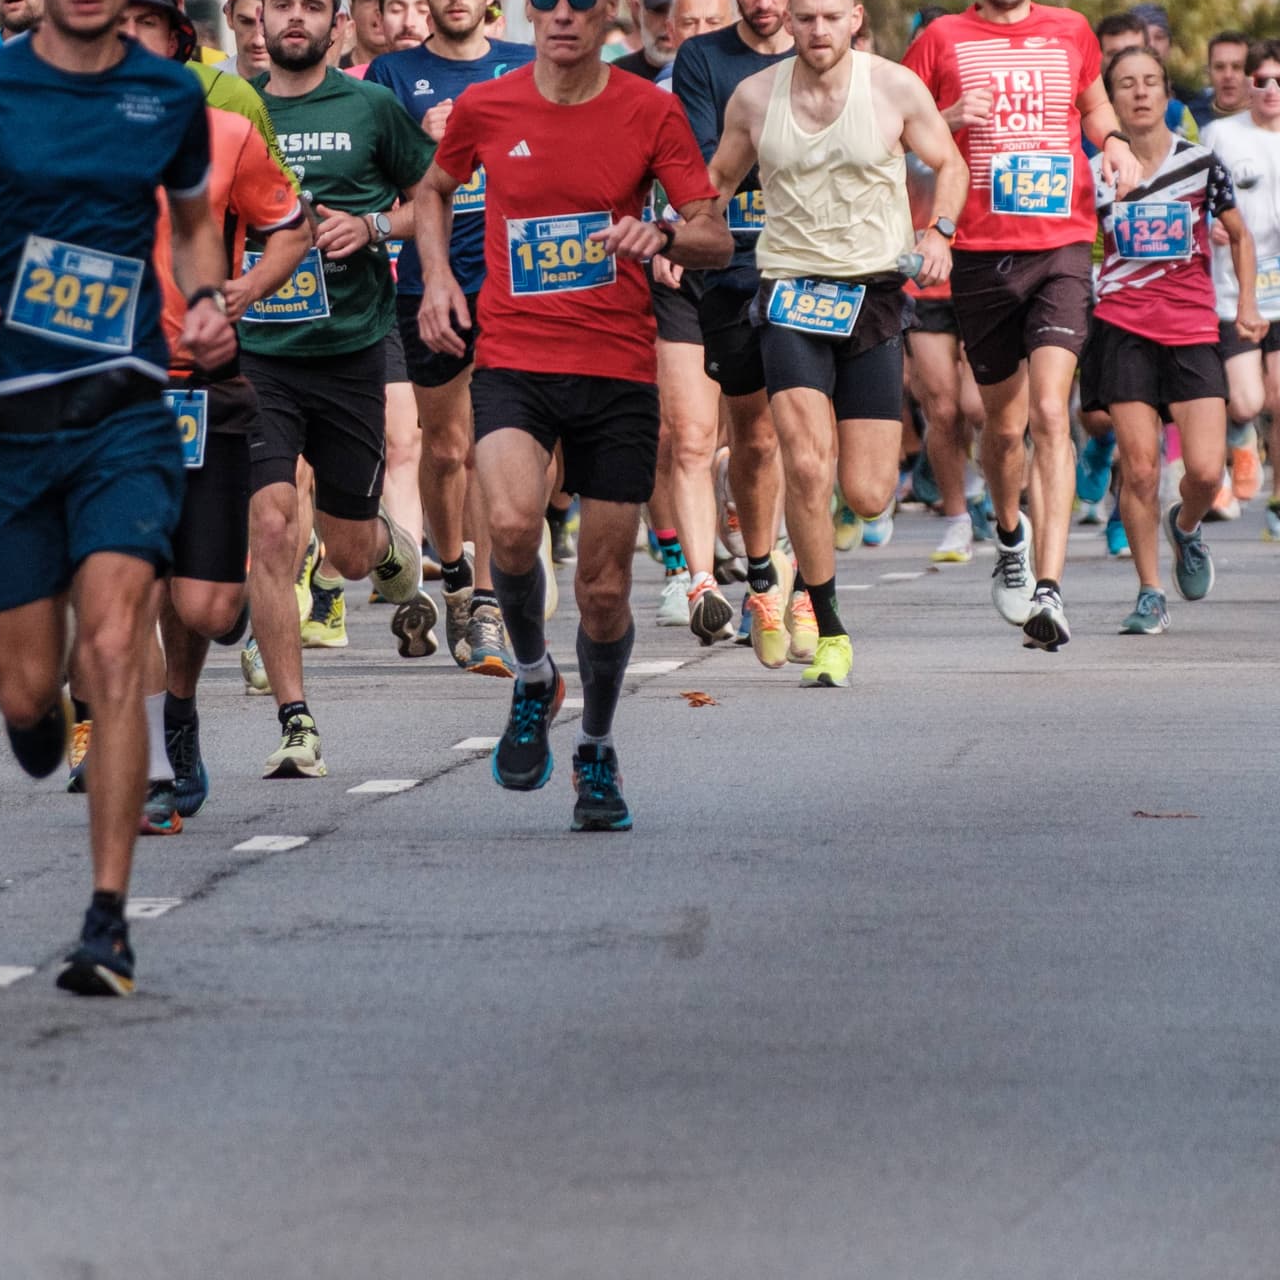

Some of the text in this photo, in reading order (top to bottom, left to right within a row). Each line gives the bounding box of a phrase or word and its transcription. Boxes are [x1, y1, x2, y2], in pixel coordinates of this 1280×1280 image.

[992, 70, 1043, 93] TRI
[995, 93, 1044, 112] ATH
[995, 113, 1044, 132] LON
[1002, 142, 1041, 152] PONTIVY
[999, 173, 1068, 196] 1542
[1020, 197, 1048, 208] Cyril
[1117, 218, 1185, 241] 1324
[516, 238, 607, 270] 1308
[542, 271, 583, 285] Jean-
[24, 267, 129, 319] 2017
[253, 300, 308, 313] Clément
[780, 289, 853, 320] 1950
[52, 309, 94, 332] Alex
[786, 311, 834, 328] Nicolas
